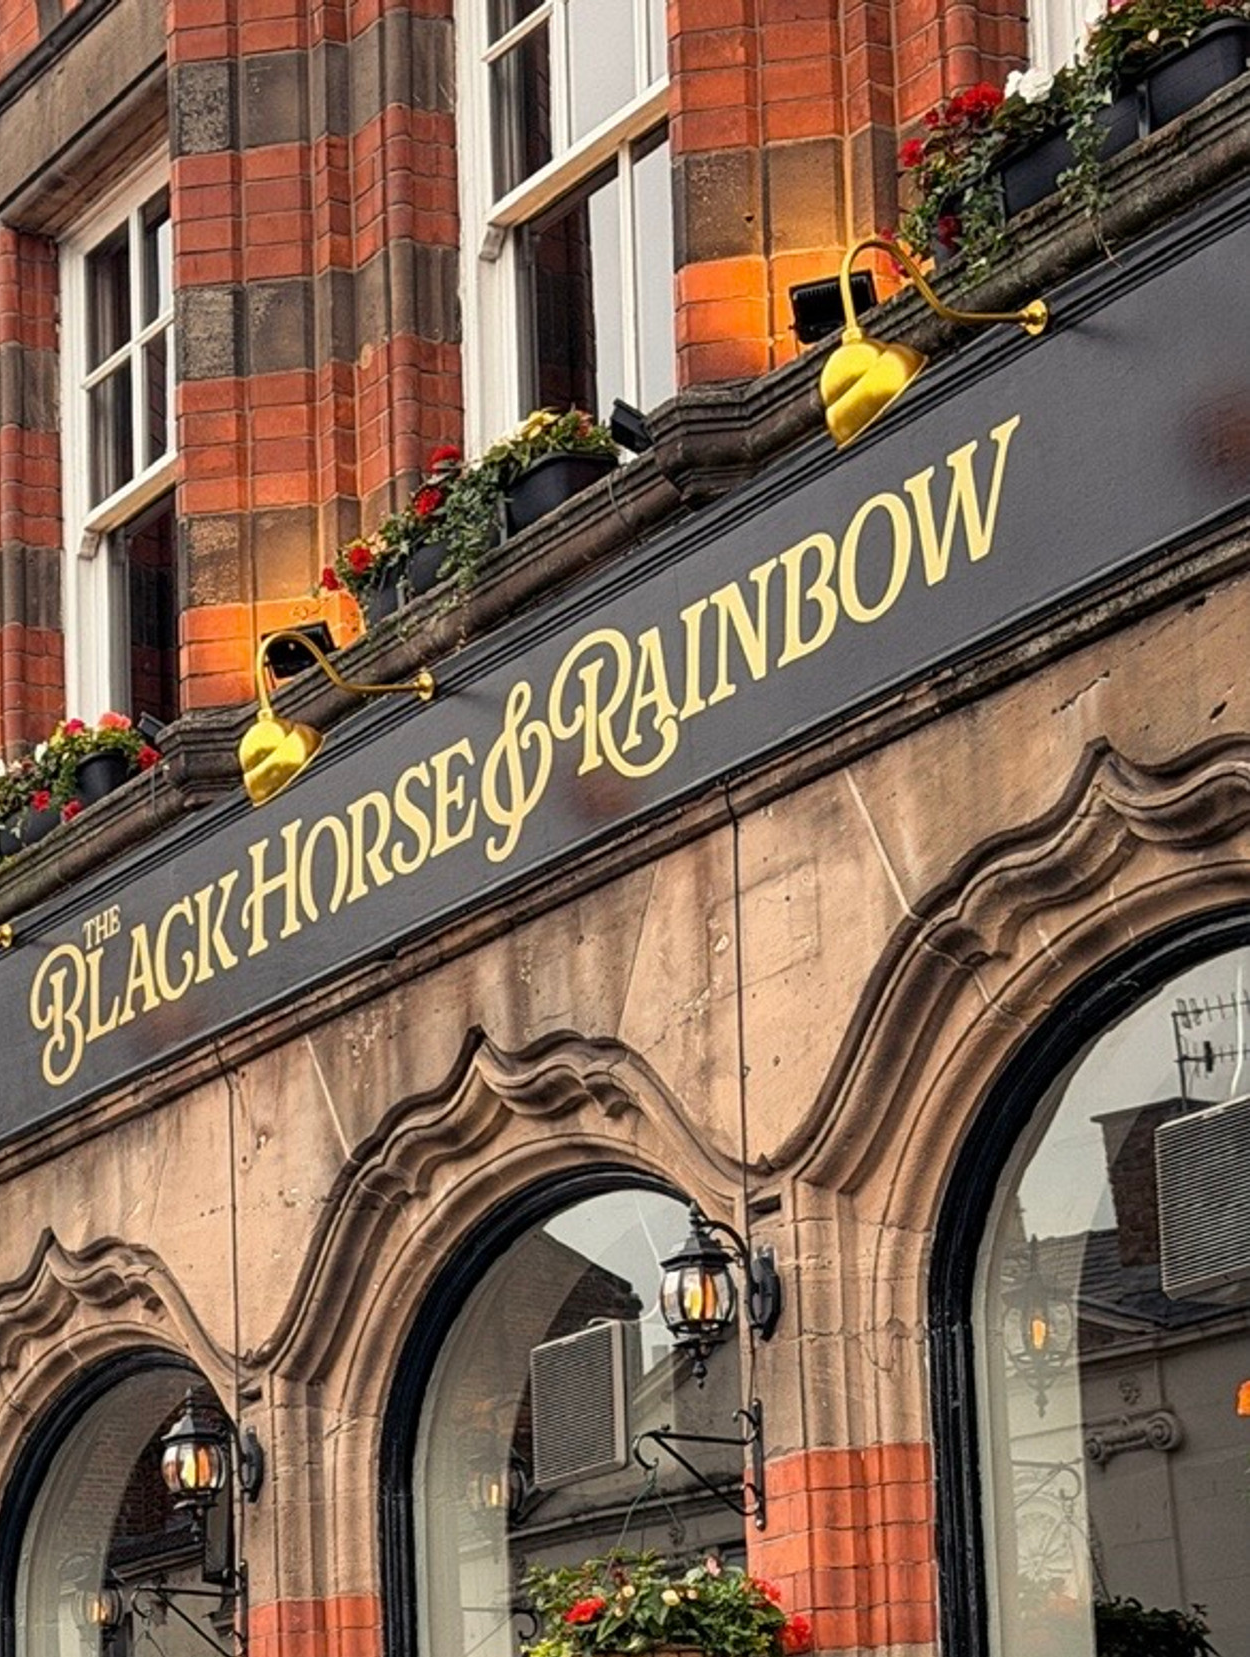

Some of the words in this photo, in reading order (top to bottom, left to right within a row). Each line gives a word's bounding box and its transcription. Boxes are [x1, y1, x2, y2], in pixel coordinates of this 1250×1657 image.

[549, 415, 1020, 778] RAINBOW
[242, 737, 475, 957] HORSE
[481, 681, 552, 862] &
[30, 869, 239, 1085] BLACK
[82, 904, 121, 950] THE
